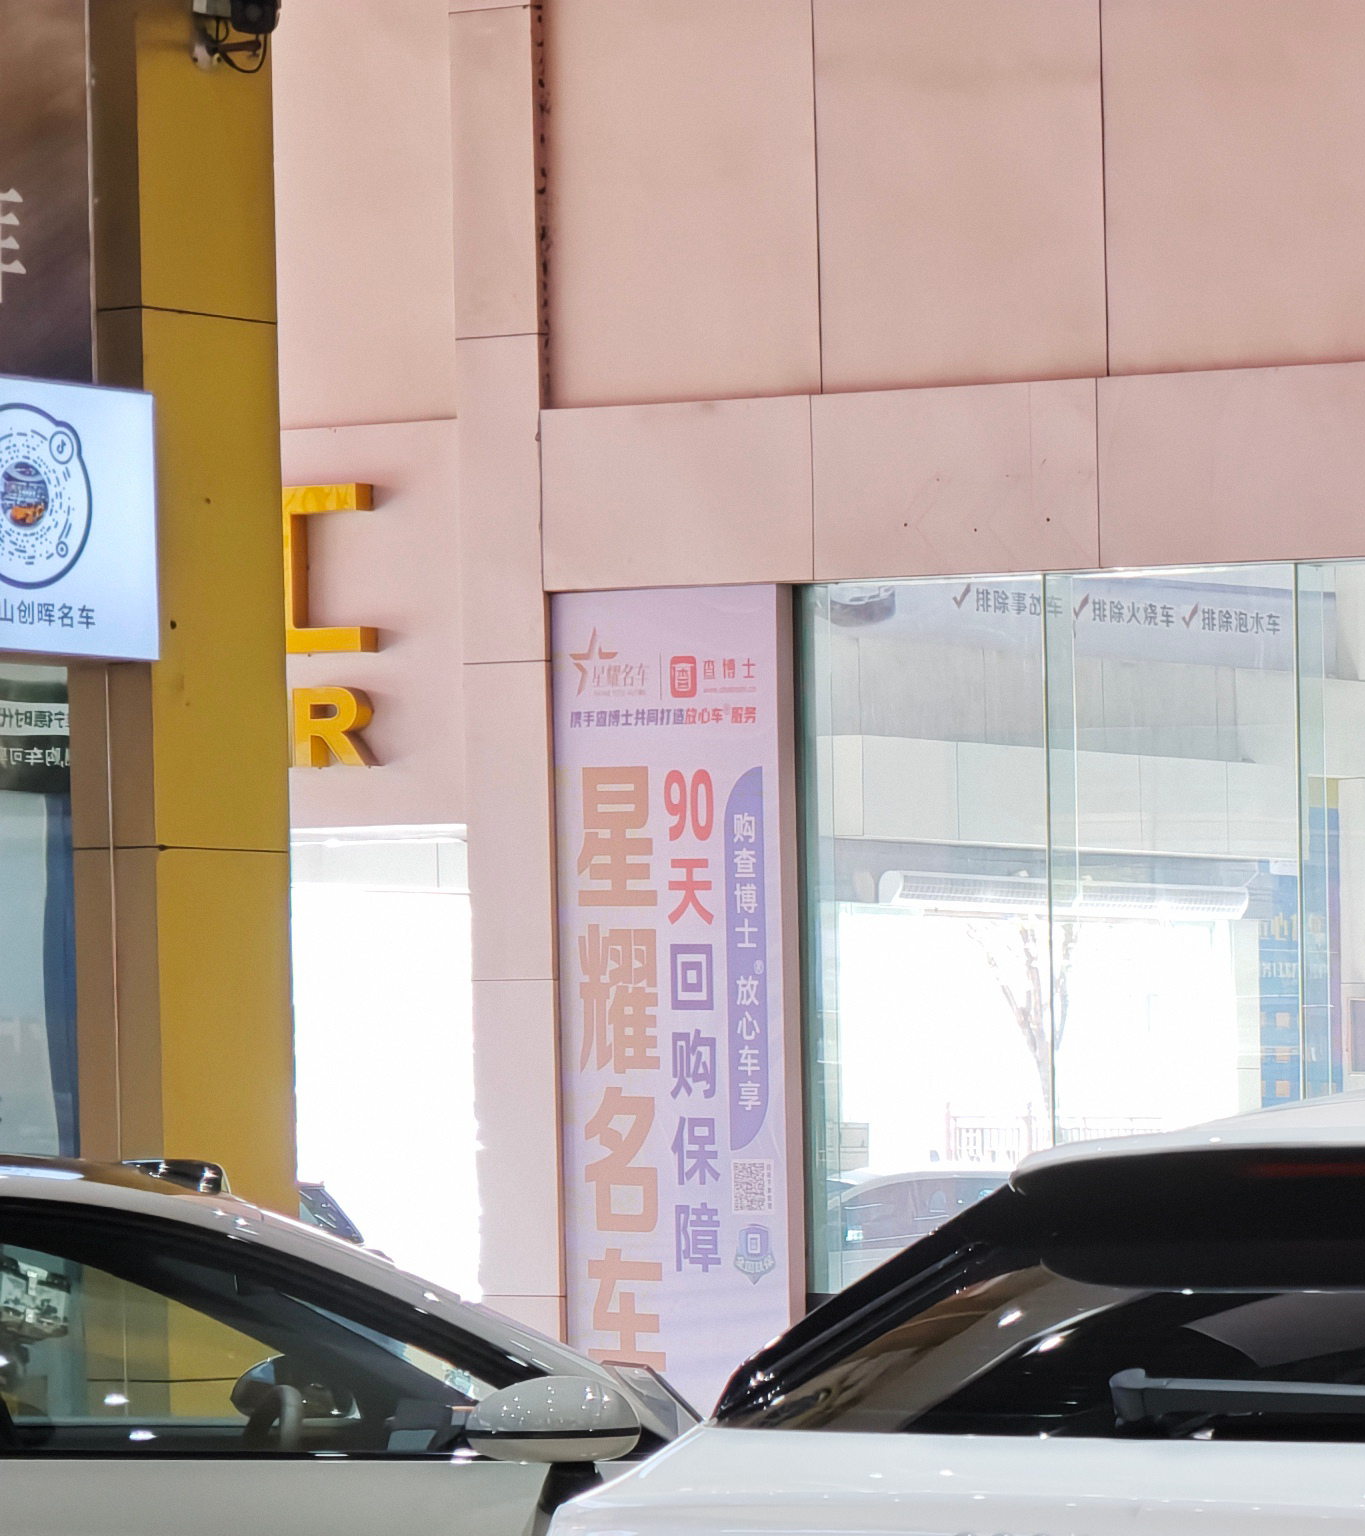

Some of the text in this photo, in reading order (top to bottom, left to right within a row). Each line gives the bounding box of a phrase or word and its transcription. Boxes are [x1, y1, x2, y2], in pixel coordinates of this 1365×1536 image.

[577, 766, 664, 1373] 星耀名车
[664, 768, 722, 1274] 90天回购保障
